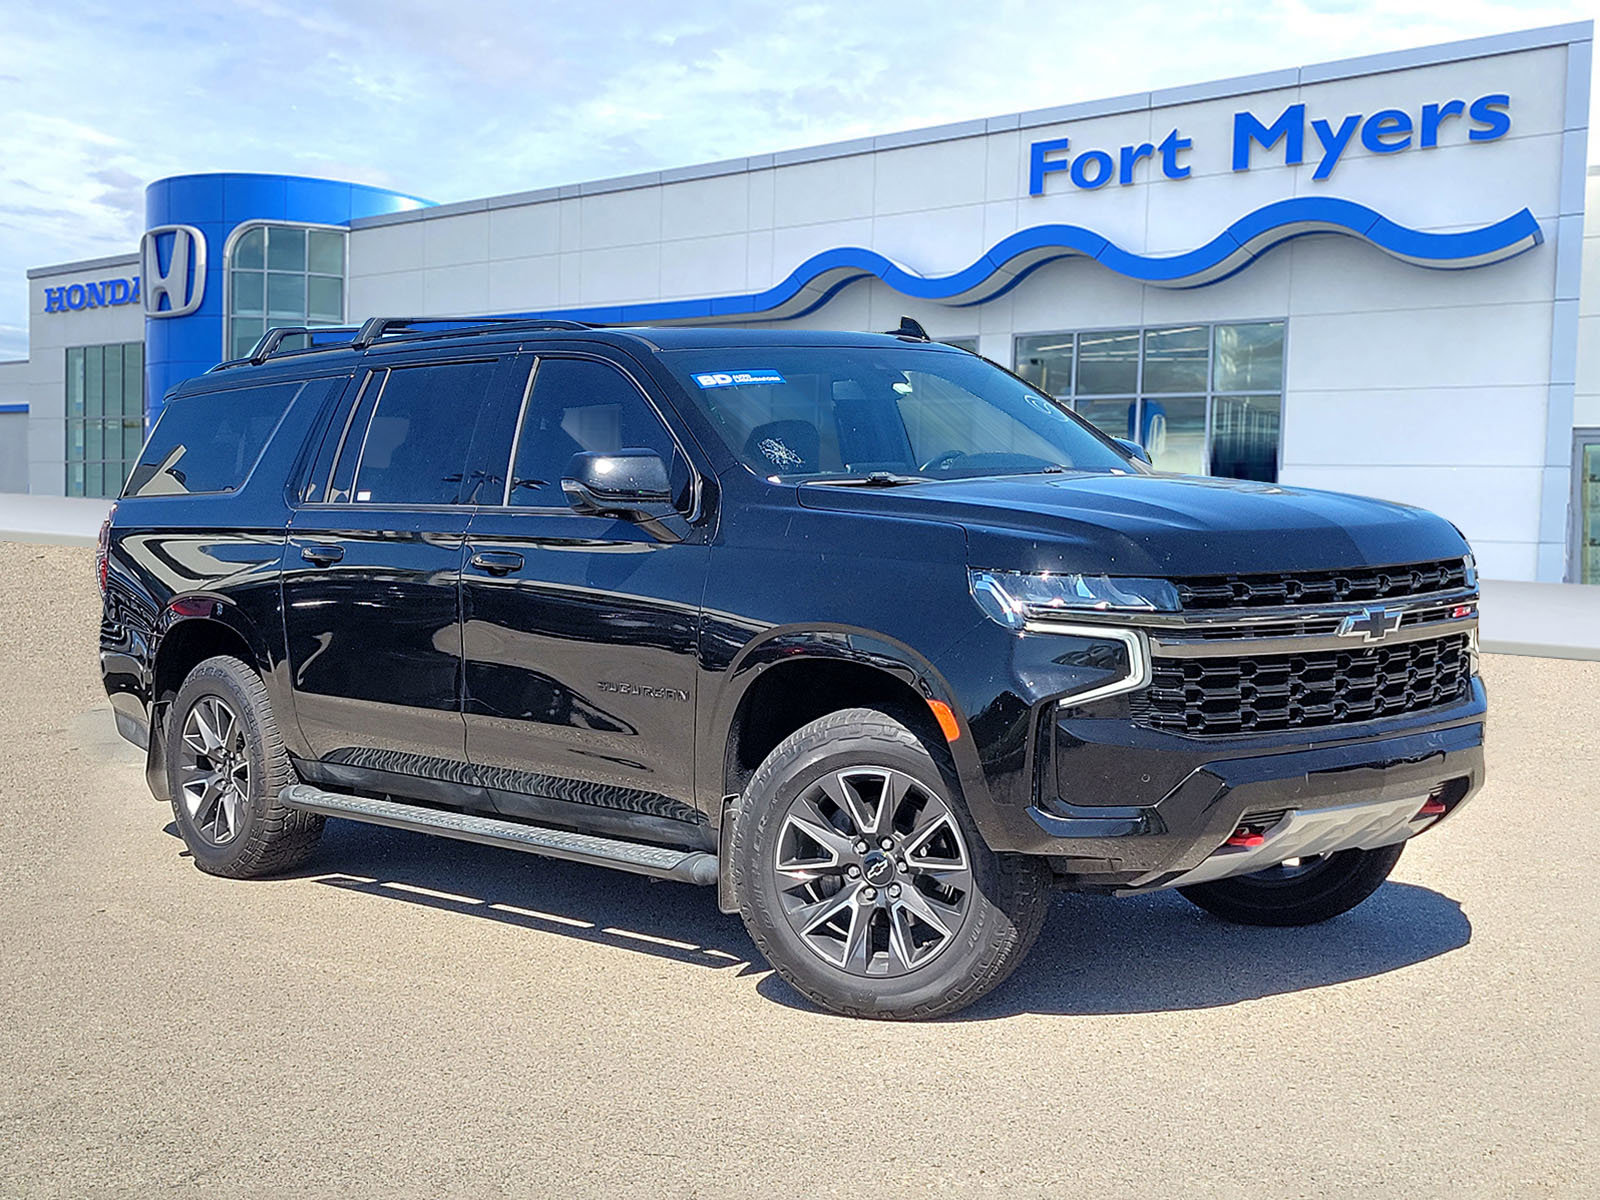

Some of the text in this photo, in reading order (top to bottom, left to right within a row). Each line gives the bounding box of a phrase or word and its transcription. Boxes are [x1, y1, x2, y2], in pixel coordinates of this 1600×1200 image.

[1028, 93, 1512, 197] Fort Myers
[597, 681, 690, 702] SUBURBAN
